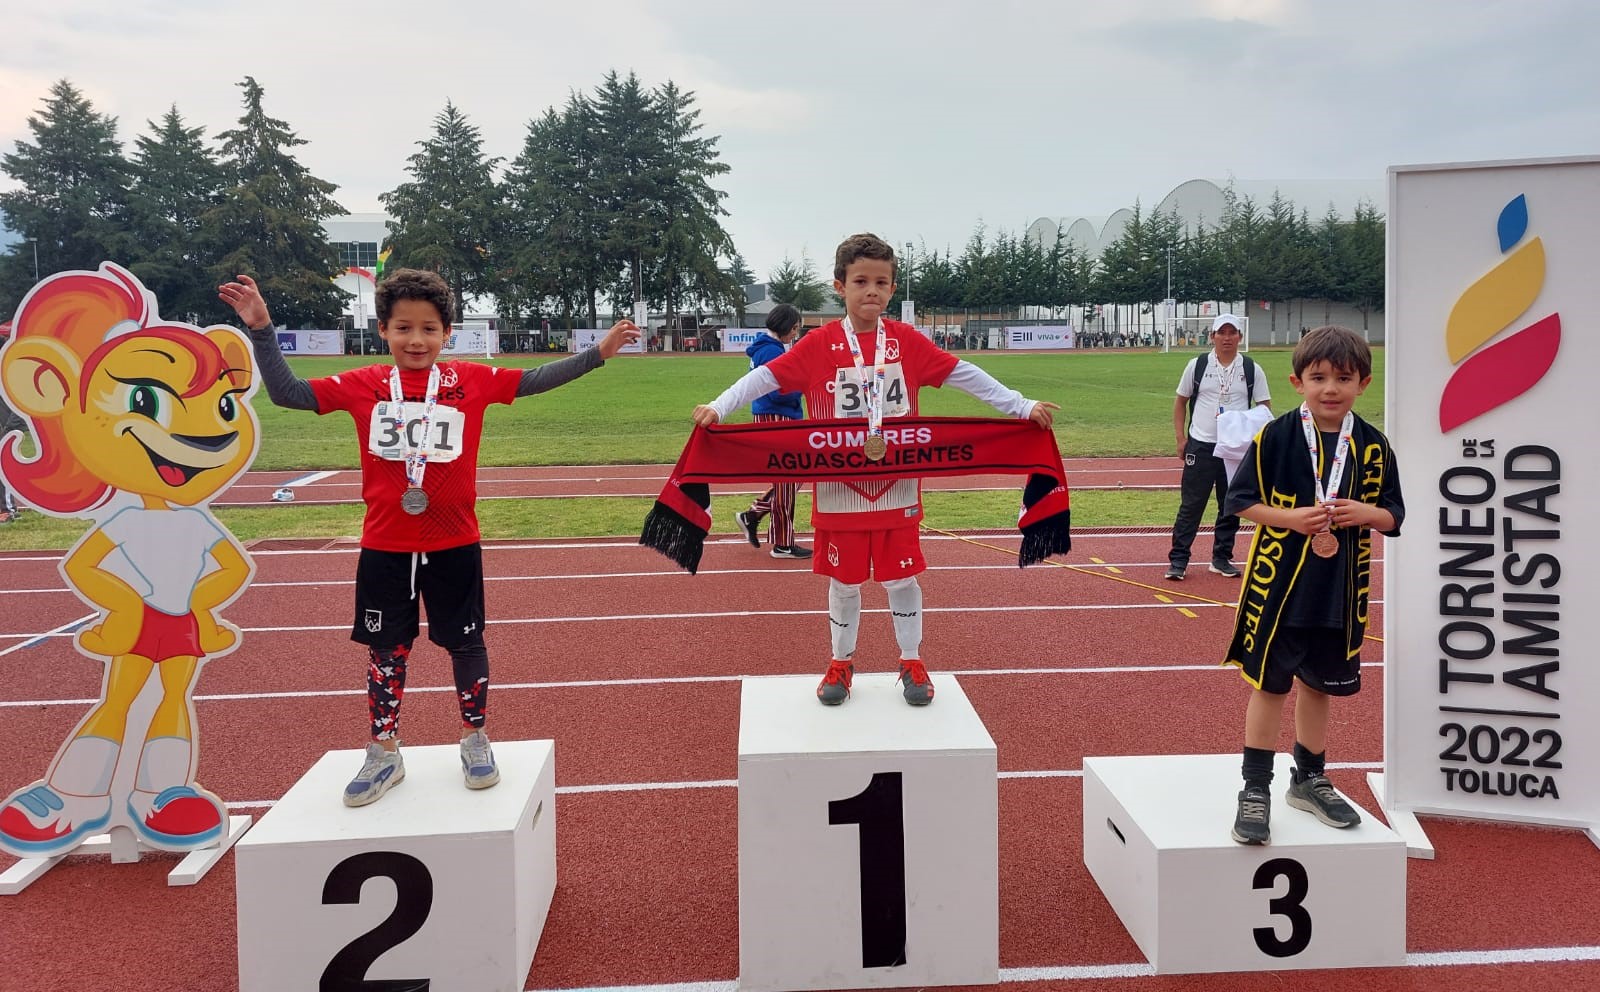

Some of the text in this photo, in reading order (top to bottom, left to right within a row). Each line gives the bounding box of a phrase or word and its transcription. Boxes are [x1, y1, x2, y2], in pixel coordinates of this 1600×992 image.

[279, 341, 294, 350] AXA
[728, 332, 755, 343] infin
[808, 427, 932, 450] CUMRES
[1462, 438, 1477, 458] DE
[1480, 438, 1495, 458] LA
[767, 444, 974, 470] AGUASCLIENTES
[1438, 465, 1496, 694] TORNEO
[1502, 444, 1561, 701] AMISTAD
[1438, 722, 1563, 769] 2022
[1440, 767, 1560, 799] TOLUCA
[828, 772, 907, 968] 1
[319, 851, 433, 992] 2
[1252, 857, 1312, 958] 3
